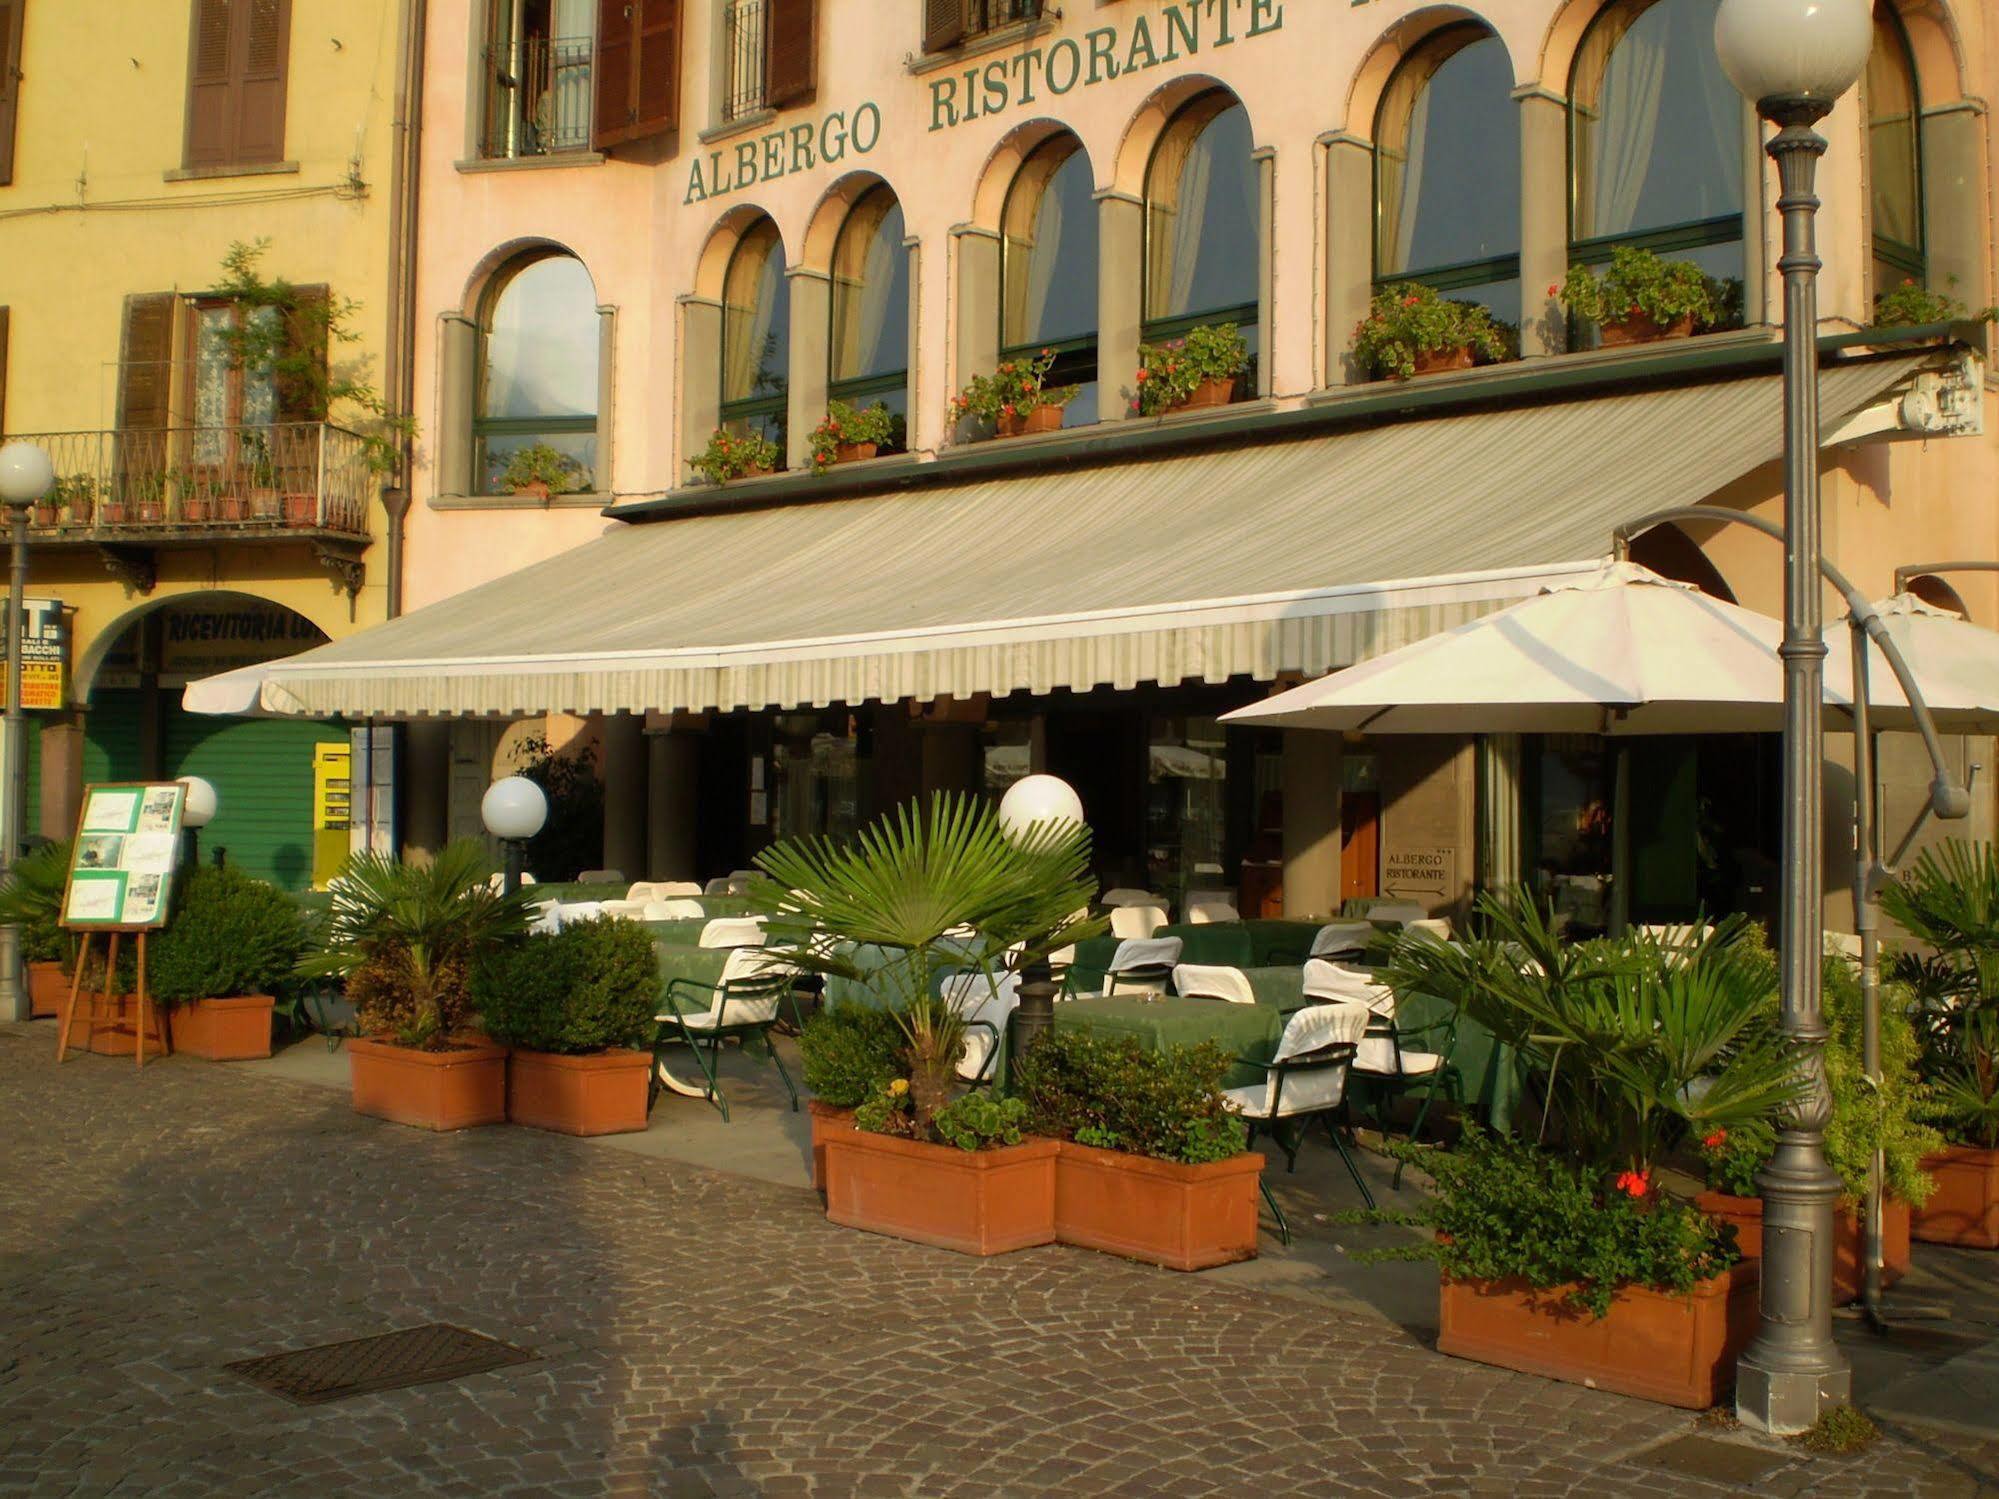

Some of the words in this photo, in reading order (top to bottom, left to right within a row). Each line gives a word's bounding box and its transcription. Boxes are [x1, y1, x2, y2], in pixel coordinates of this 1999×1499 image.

[683, 102, 881, 205] ALBERGO
[928, 0, 1283, 132] RISTORANTE
[169, 613, 286, 641] RICEVITORIA
[1388, 854, 1442, 866] ALBERGO
[1386, 868, 1445, 880] RISTORANTE
